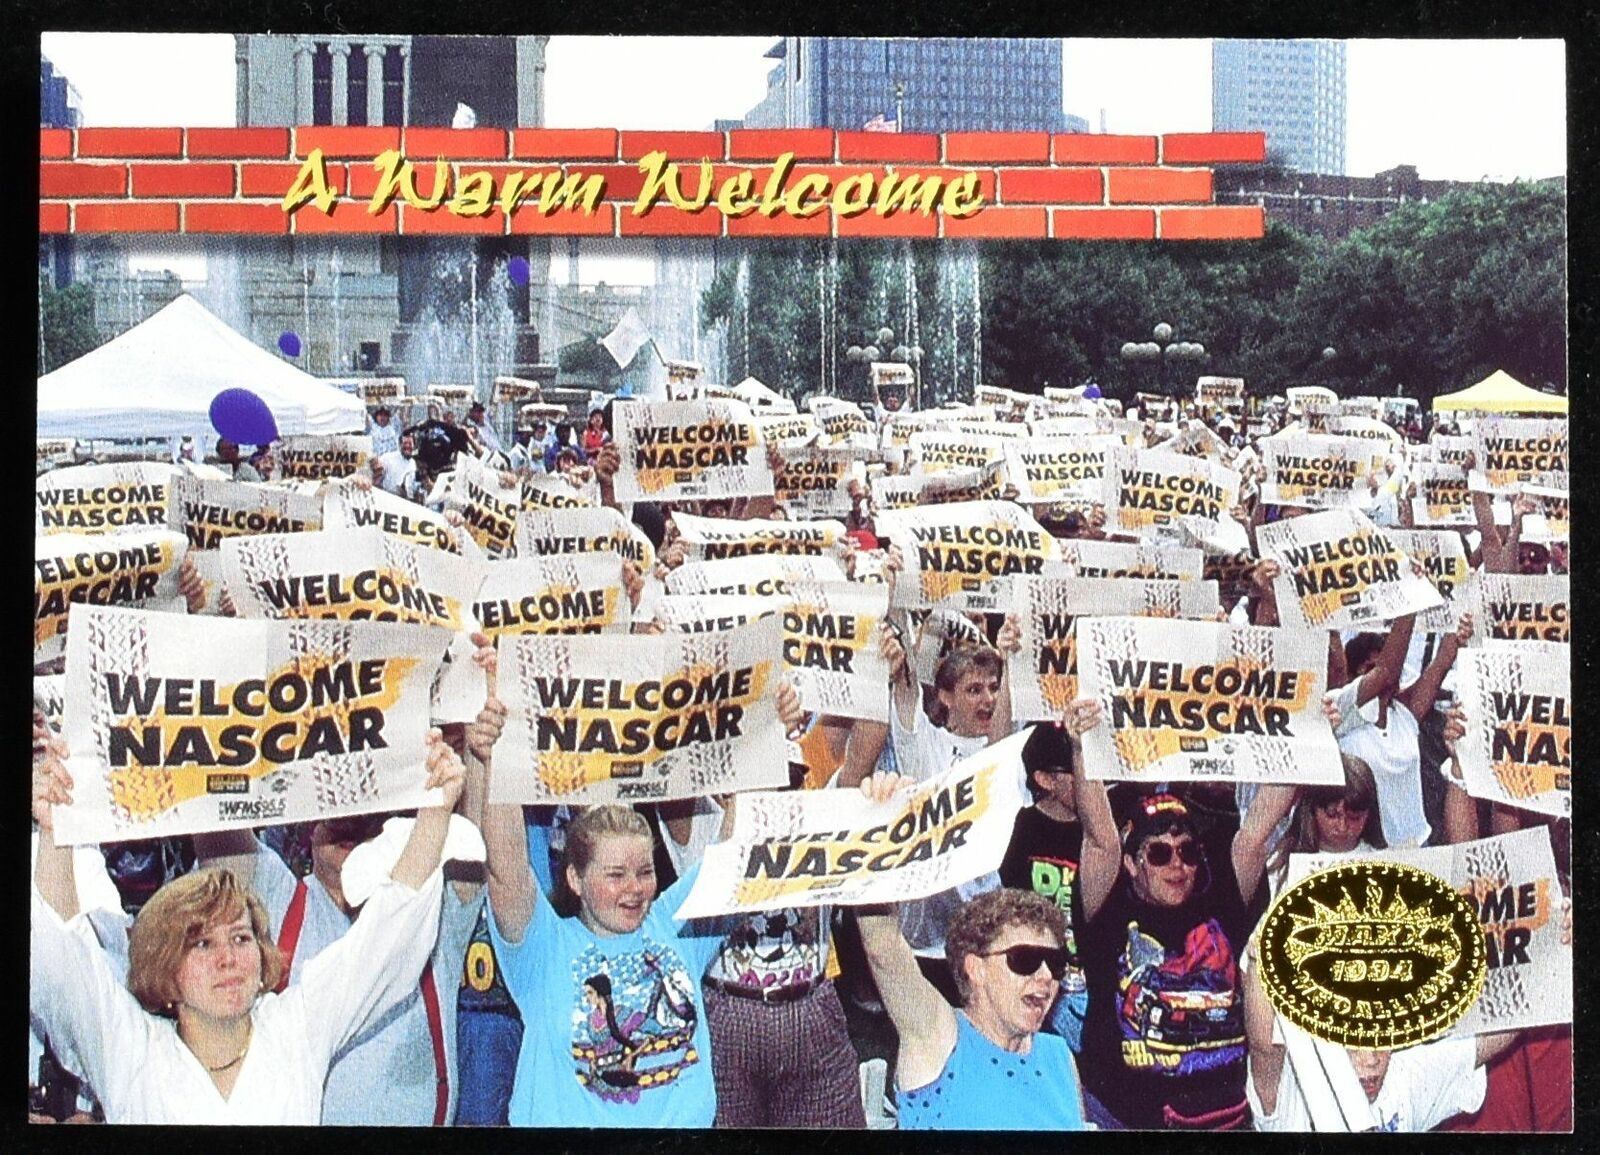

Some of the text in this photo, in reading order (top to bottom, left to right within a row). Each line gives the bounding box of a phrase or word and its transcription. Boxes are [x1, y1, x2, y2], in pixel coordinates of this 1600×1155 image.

[635, 423, 750, 446] WELCOME
[282, 449, 359, 464] WELCOME
[636, 445, 749, 470] NASCAR
[922, 452, 987, 467] NASCAR
[1276, 454, 1359, 474] WELCOME
[37, 484, 166, 507] WELCOME
[1121, 469, 1224, 502] WELCOME
[1275, 470, 1356, 490] NASCAR
[41, 506, 167, 528] NASCAR
[185, 501, 305, 533] WELCOME
[1119, 487, 1221, 524] NASCAR
[911, 525, 1041, 551] WELCOME
[1285, 534, 1397, 568] WELCOME
[919, 547, 1045, 577] NASCAR
[1292, 557, 1402, 598] NASCAR
[35, 570, 160, 619] ASCAR
[261, 569, 450, 620] WELCOME
[1489, 602, 1567, 623] WELC
[105, 659, 386, 718] WELCOME
[535, 666, 754, 711] WELCOME
[1107, 659, 1300, 701] WELCOME
[1112, 698, 1296, 738] NASCAR
[1490, 691, 1569, 726] WEL
[108, 705, 390, 768] NASCAR
[537, 705, 745, 755] NASCAR
[744, 819, 974, 879] NASCAR
